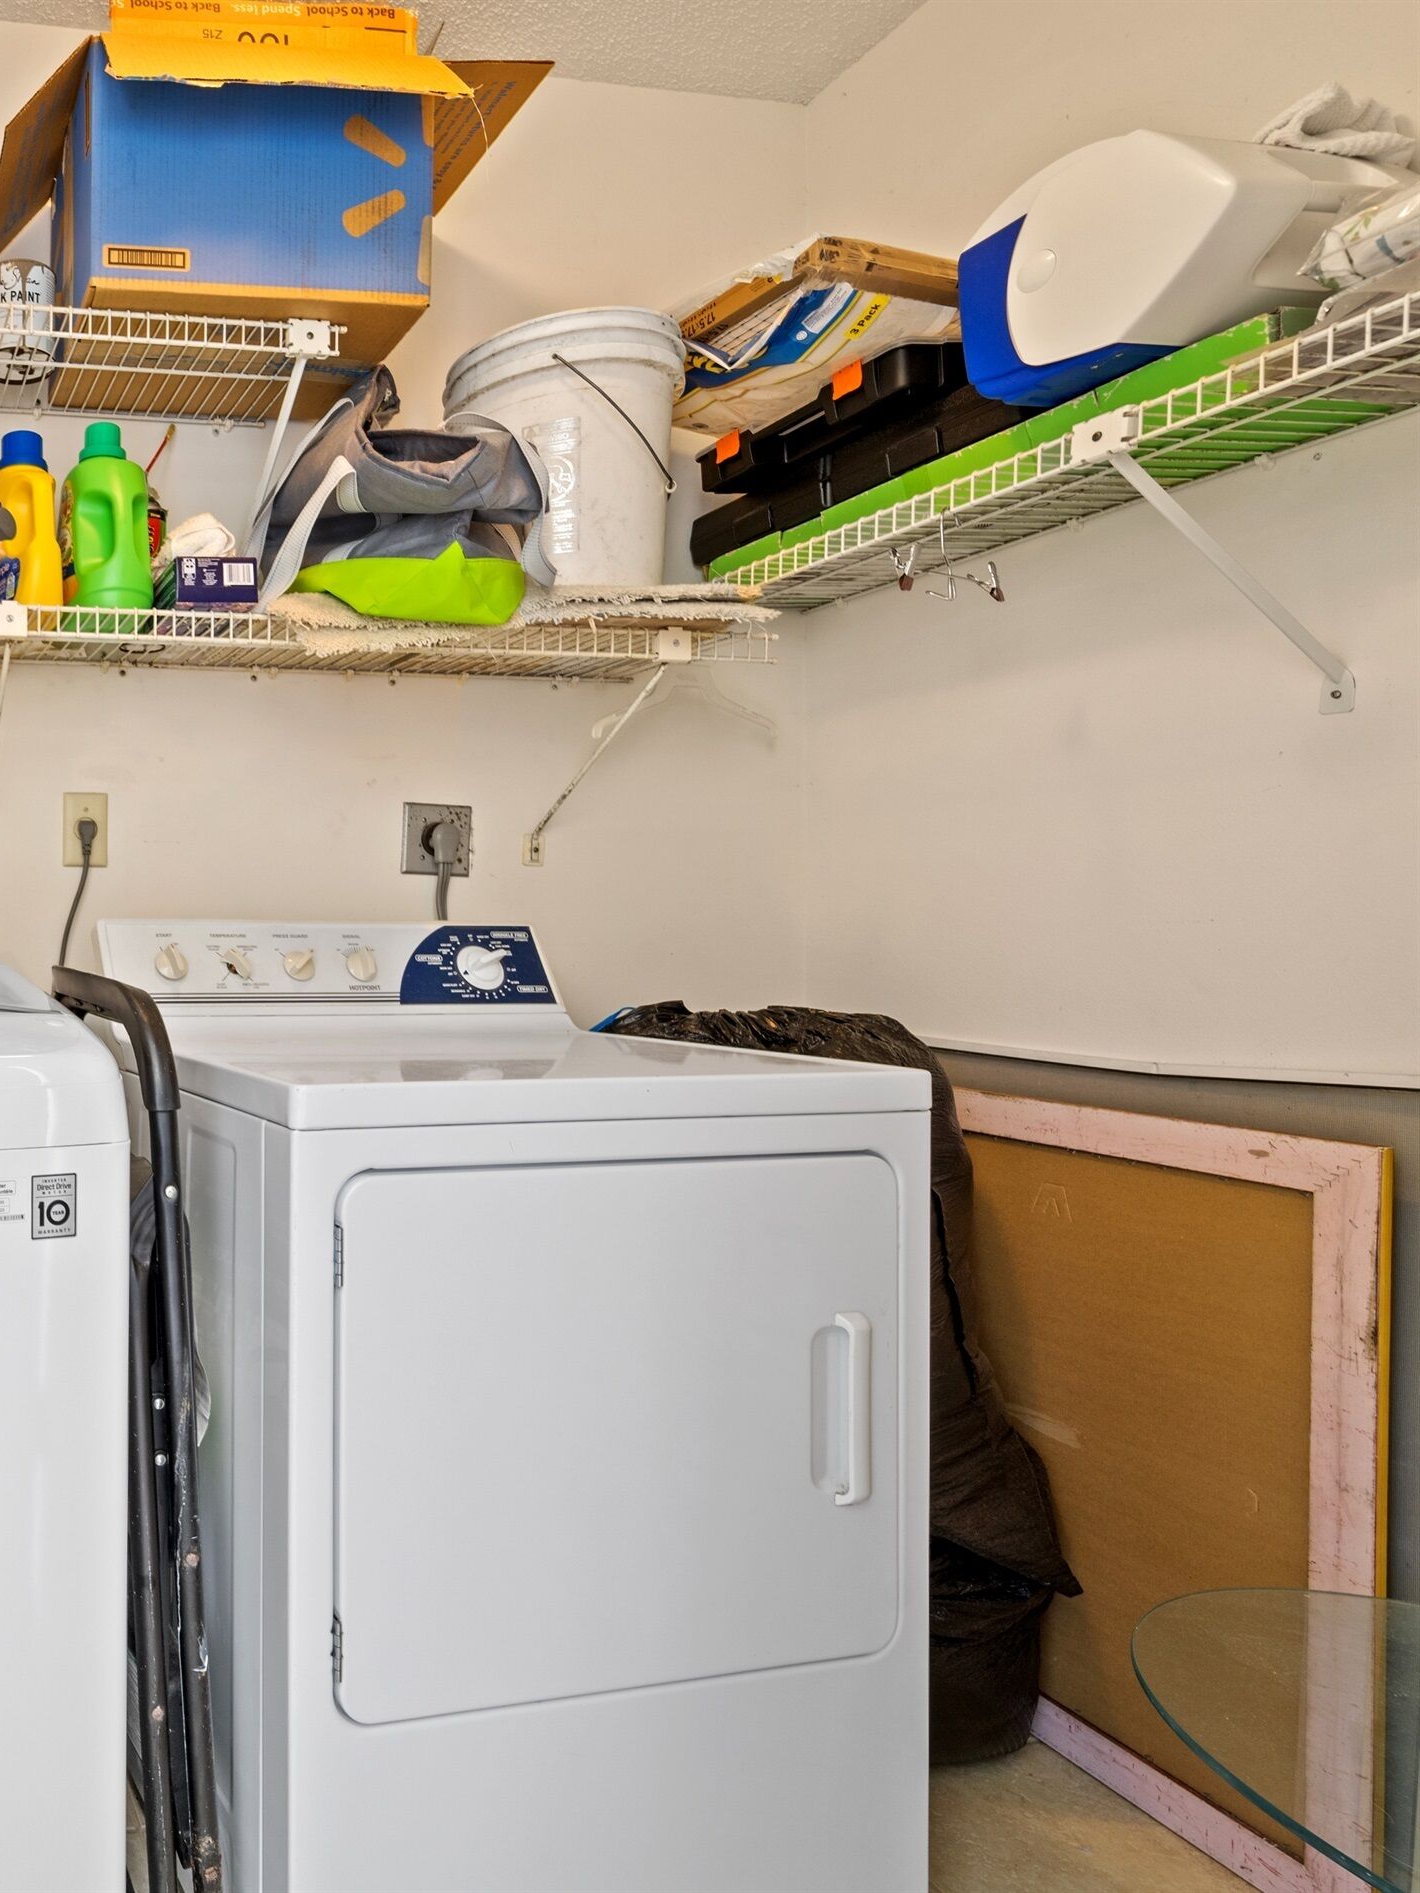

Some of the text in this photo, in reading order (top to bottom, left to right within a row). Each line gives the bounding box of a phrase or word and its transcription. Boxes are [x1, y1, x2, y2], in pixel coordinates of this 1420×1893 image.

[131, 0, 172, 11] School
[175, 2, 187, 10] to
[192, 3, 221, 13] Back
[262, 4, 301, 16] Spend
[307, 6, 348, 17] School
[351, 7, 363, 16] to
[367, 7, 395, 19] Back
[203, 28, 222, 39] Z15
[10, 290, 40, 303] PANT
[857, 304, 881, 327] Pack
[38, 1200, 70, 1226] 10
